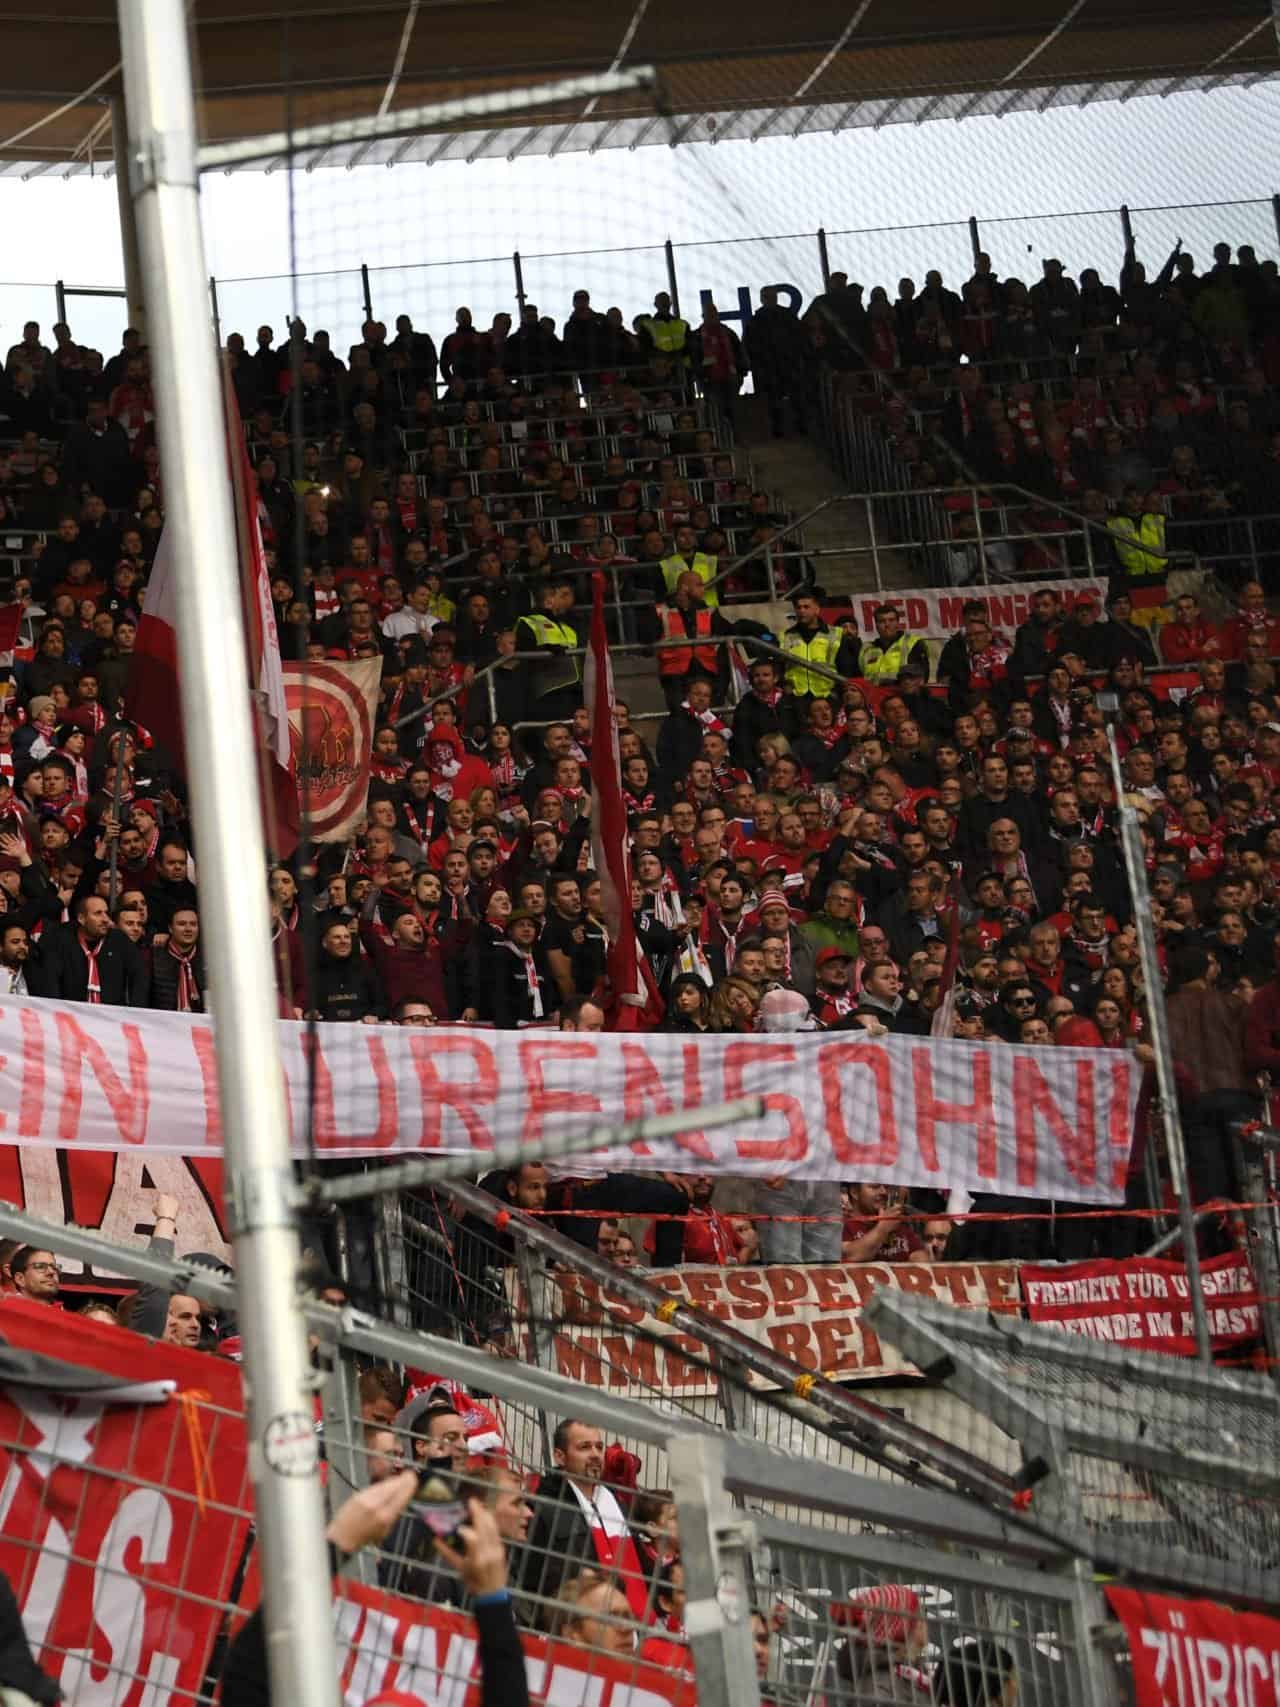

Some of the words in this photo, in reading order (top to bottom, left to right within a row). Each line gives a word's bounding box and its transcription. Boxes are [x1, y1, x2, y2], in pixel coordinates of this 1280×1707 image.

[1026, 1275, 1121, 1306] FREIHEIT
[1124, 1267, 1168, 1298] FÜR
[1170, 1266, 1253, 1298] USERE
[1145, 1311, 1175, 1337] IM
